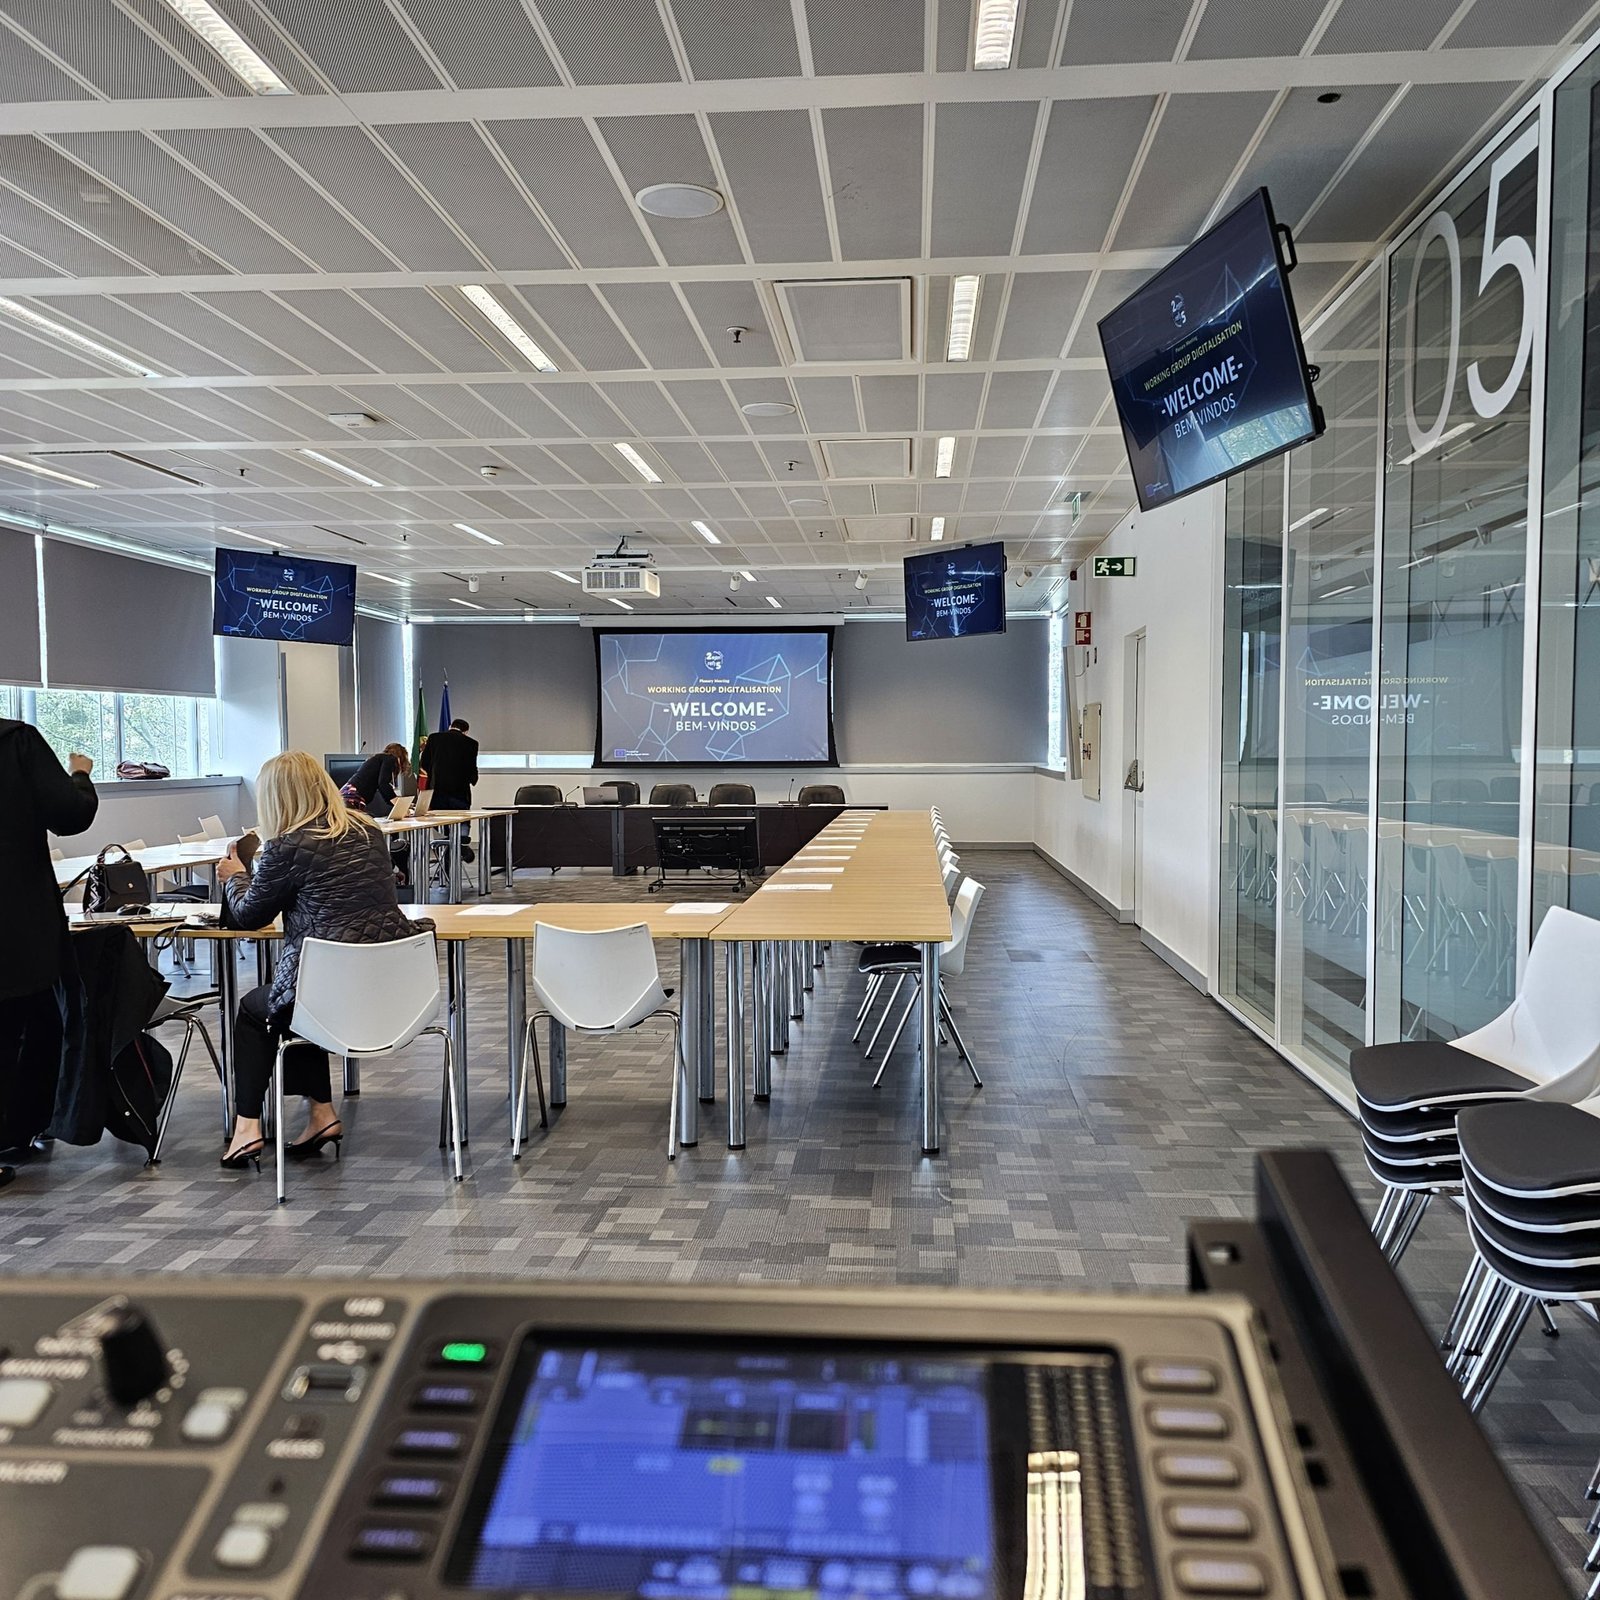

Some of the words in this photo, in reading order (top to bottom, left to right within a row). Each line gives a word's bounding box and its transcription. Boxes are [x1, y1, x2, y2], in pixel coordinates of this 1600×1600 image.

[1404, 119, 1540, 454] 05
[1143, 368, 1171, 391] WORKING
[1171, 354, 1191, 374] GROUP
[1191, 320, 1243, 361] DIGITALISATION
[1174, 393, 1235, 438] BEM-VINDOS
[262, 611, 312, 622] BEM-VINDOS
[647, 686, 687, 694] WORKING
[688, 686, 717, 694] GROUP
[718, 686, 782, 694] DIGITALISATION
[675, 720, 757, 732] BEM-VINDOS
